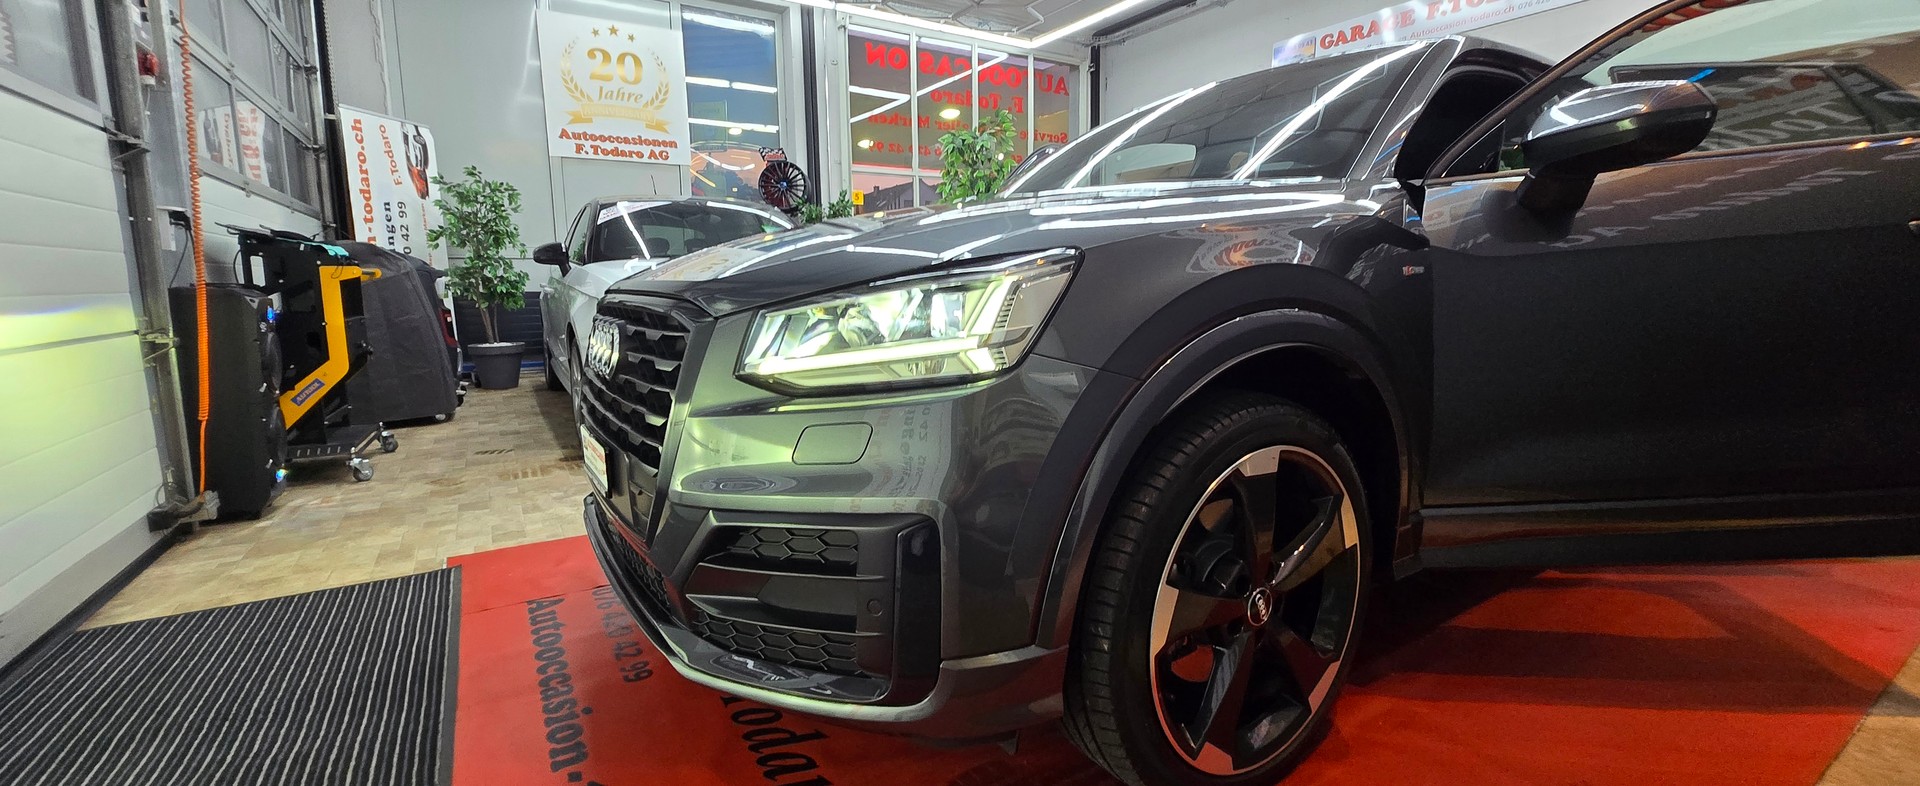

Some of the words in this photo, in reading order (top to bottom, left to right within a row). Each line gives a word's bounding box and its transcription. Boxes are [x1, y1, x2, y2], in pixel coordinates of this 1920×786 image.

[1319, 8, 1416, 50] GARAGE
[587, 47, 643, 86] 20
[598, 85, 643, 104] Jahre
[558, 127, 678, 149] Autooccasionen
[647, 148, 670, 161] AG
[397, 200, 408, 219] 99
[383, 201, 397, 251] ngen
[399, 223, 411, 243] 42
[614, 640, 644, 661] 42
[619, 660, 654, 683] 99
[526, 597, 604, 786] Autooccasion-
